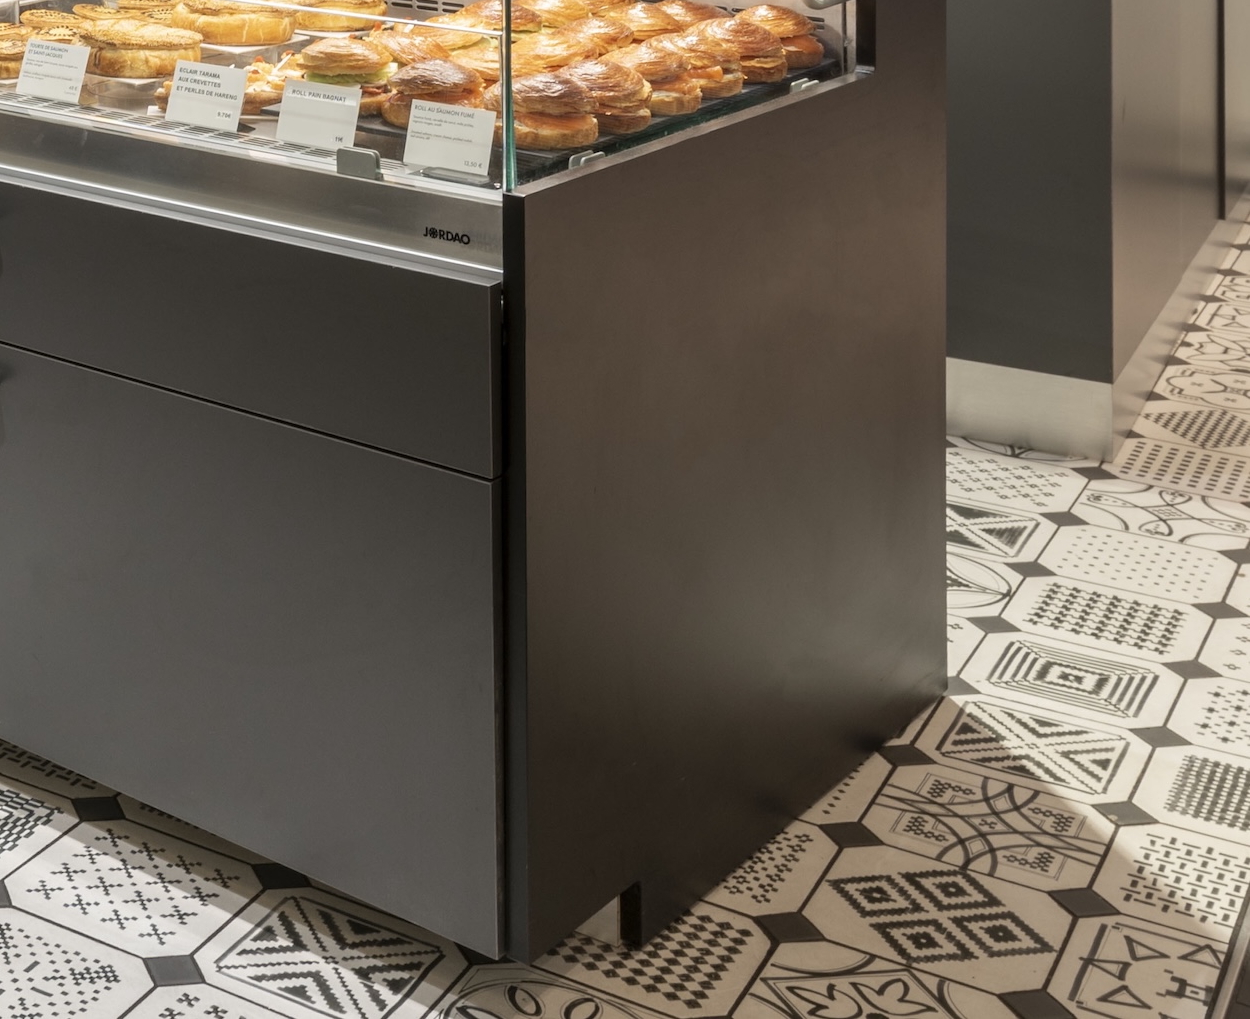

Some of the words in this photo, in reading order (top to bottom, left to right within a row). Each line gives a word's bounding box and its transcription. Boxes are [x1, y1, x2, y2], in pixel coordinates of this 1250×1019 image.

[179, 67, 198, 75] ECLAIR
[199, 70, 221, 79] TARAMA
[189, 78, 221, 88] CREVETTES
[184, 86, 205, 95] PERLES
[214, 91, 238, 101] HARENG
[292, 89, 307, 97] ROLL
[307, 91, 322, 99] PAIN
[322, 94, 347, 103] BAGNAT
[414, 104, 428, 112] ROLL
[436, 108, 460, 117] SAUMON
[460, 111, 475, 119] FUMÉ
